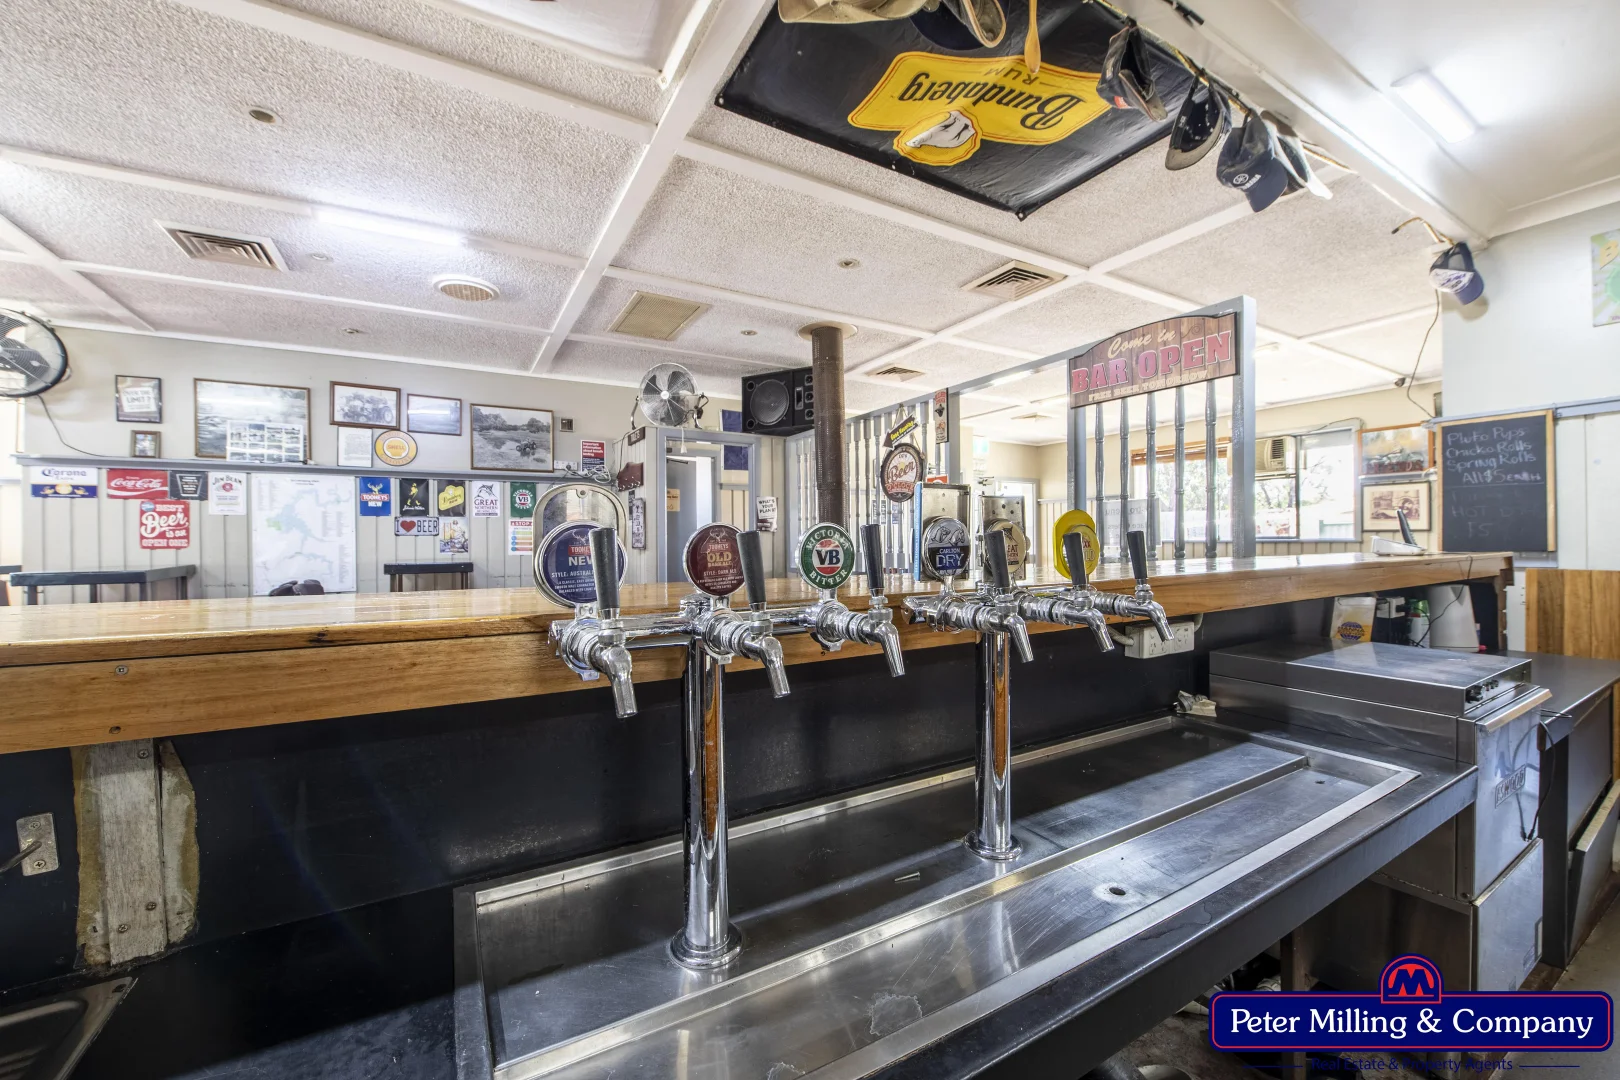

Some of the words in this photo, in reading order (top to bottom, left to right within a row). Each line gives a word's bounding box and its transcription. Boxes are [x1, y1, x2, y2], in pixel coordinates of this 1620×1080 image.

[984, 67, 1039, 86] RUM
[898, 72, 1086, 130] Bundaberg
[1107, 335, 1151, 358] Come
[1157, 329, 1176, 343] in
[1072, 358, 1128, 394] BAR
[1138, 331, 1231, 379] OPEN
[1089, 391, 1112, 401] FREE
[1114, 385, 1140, 396] BEER
[1142, 370, 1208, 391] TOMORROW
[1447, 431, 1489, 446] Pluto
[1492, 426, 1525, 441] Pups
[1496, 440, 1532, 453] Rolls
[1446, 457, 1498, 473] Spring
[1500, 451, 1537, 465] Rolls
[42, 468, 87, 477] Corona
[889, 461, 915, 482] Beer
[110, 478, 163, 488] Coca-Cola
[212, 477, 224, 486] JIM
[225, 475, 242, 486] BEAM
[156, 504, 185, 512] BEST
[166, 529, 174, 537] is
[417, 520, 438, 533] BEER
[709, 543, 729, 551] TOOHEYS
[806, 529, 851, 550] VICTORIA
[571, 545, 592, 553] TOOHEY
[706, 551, 732, 562] OLD
[815, 549, 841, 565] VB
[936, 553, 964, 568] DRY
[809, 569, 847, 585] BITTER
